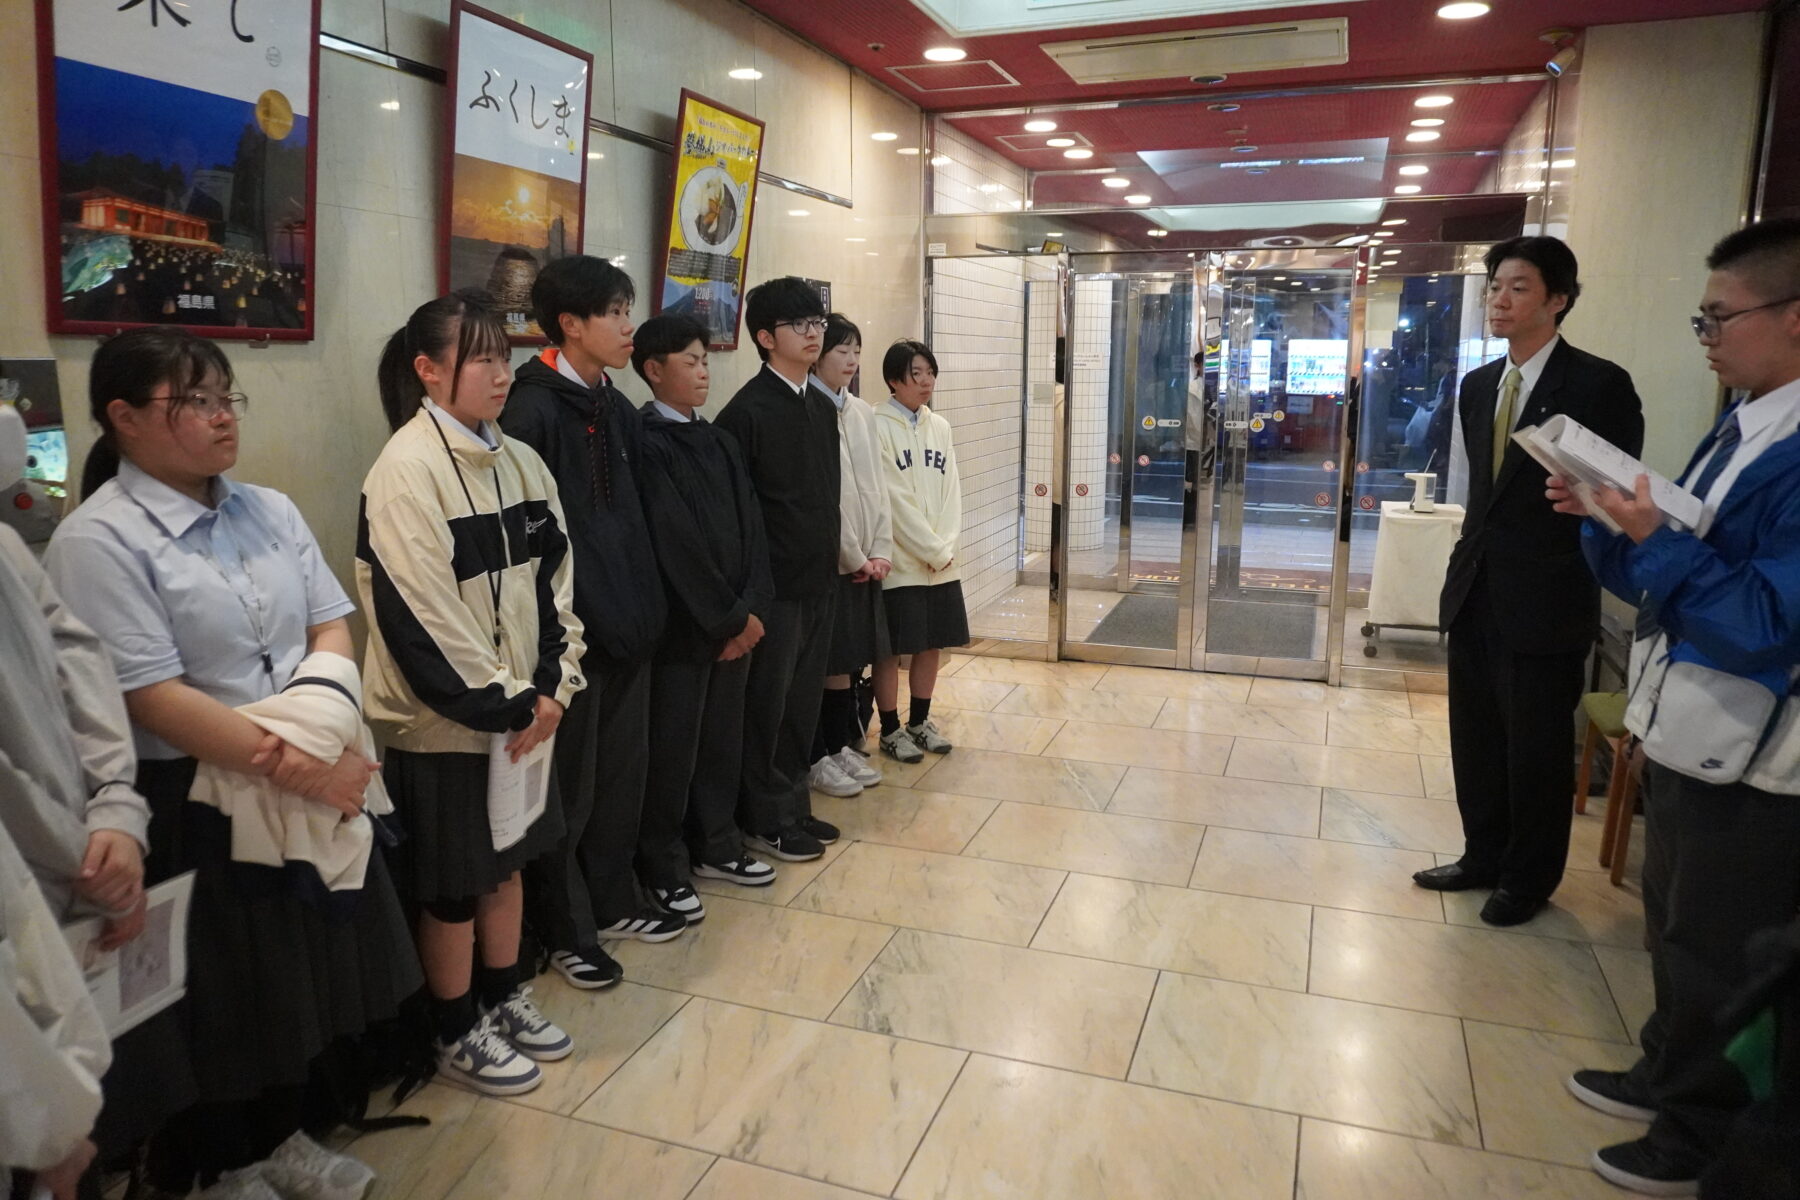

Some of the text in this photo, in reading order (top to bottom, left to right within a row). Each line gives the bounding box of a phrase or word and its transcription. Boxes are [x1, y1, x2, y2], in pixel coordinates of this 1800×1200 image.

[469, 70, 571, 138] ふくしま
[177, 294, 215, 309] 福島県
